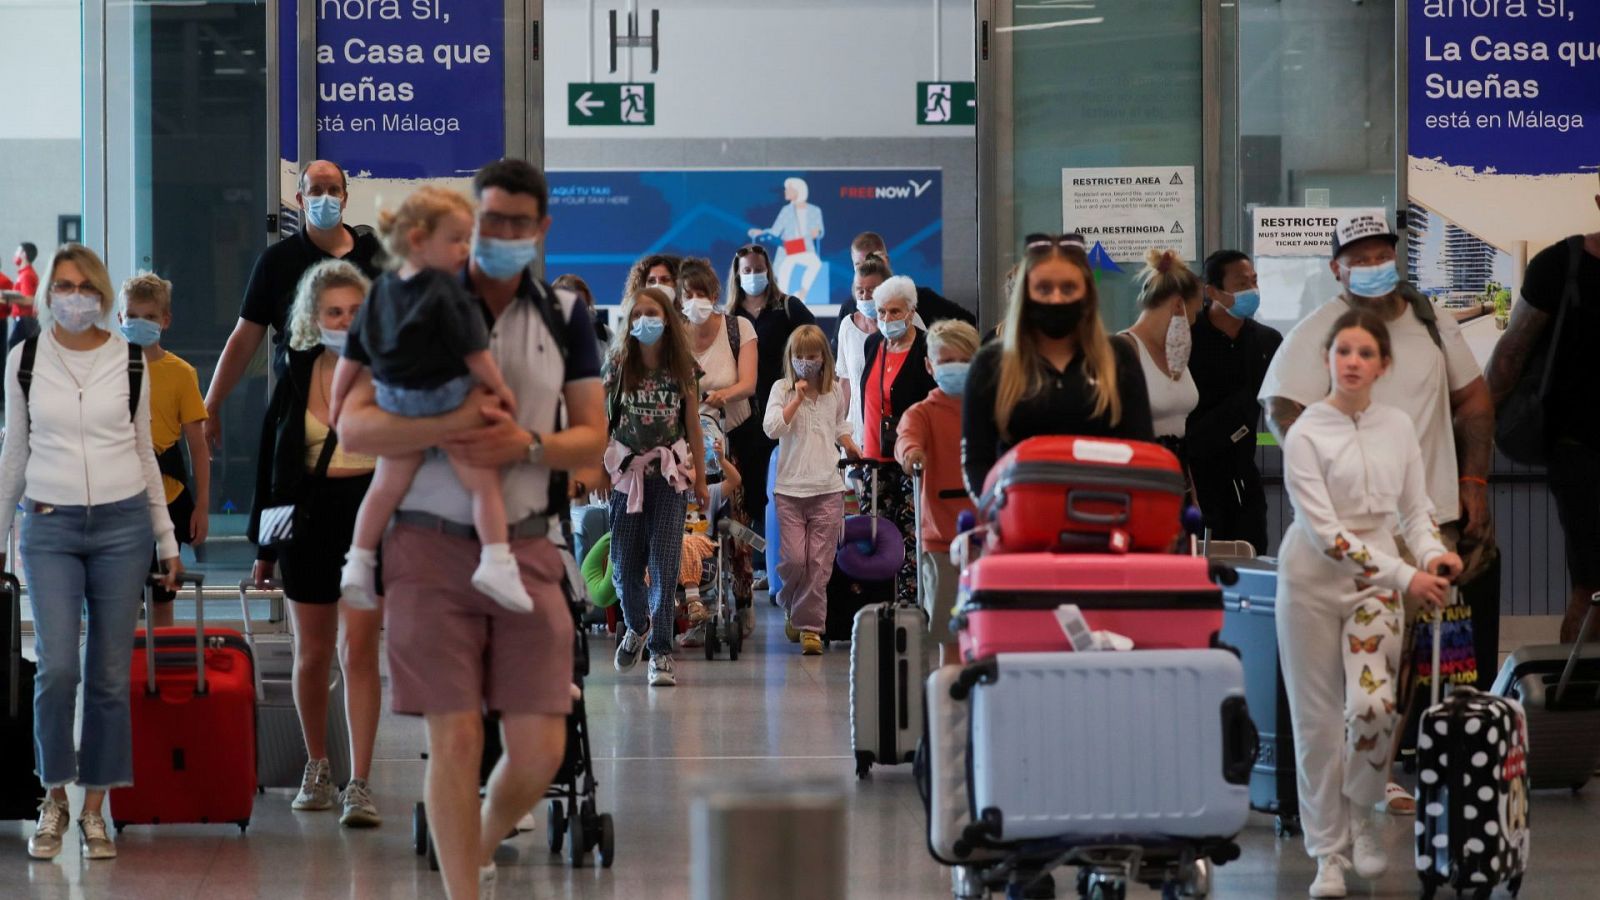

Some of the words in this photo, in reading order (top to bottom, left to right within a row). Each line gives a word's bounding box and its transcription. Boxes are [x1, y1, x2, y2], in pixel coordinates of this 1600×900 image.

[321, 0, 401, 20] hora
[1423, 0, 1528, 18] ahora
[316, 44, 335, 64] a
[344, 38, 425, 64] Casa
[433, 44, 491, 70] que
[1425, 36, 1461, 61] La
[1470, 36, 1549, 61] Casa
[1557, 41, 1600, 67] qu
[320, 76, 414, 102] ueñas
[1425, 73, 1539, 99] Sueñas
[316, 114, 345, 132] stá
[350, 117, 376, 132] en
[382, 113, 461, 135] Málaga
[1425, 111, 1471, 128] está
[1476, 114, 1501, 128] en
[1508, 110, 1584, 133] Málaga
[577, 186, 589, 195] TU
[591, 186, 611, 195] TAXI
[1073, 177, 1132, 186] RESTRICTED
[1135, 176, 1161, 184] AREA
[1074, 227, 1100, 235] AREA
[1102, 225, 1165, 234] RESTRINGIDA
[1261, 217, 1338, 227] RESTRICTED
